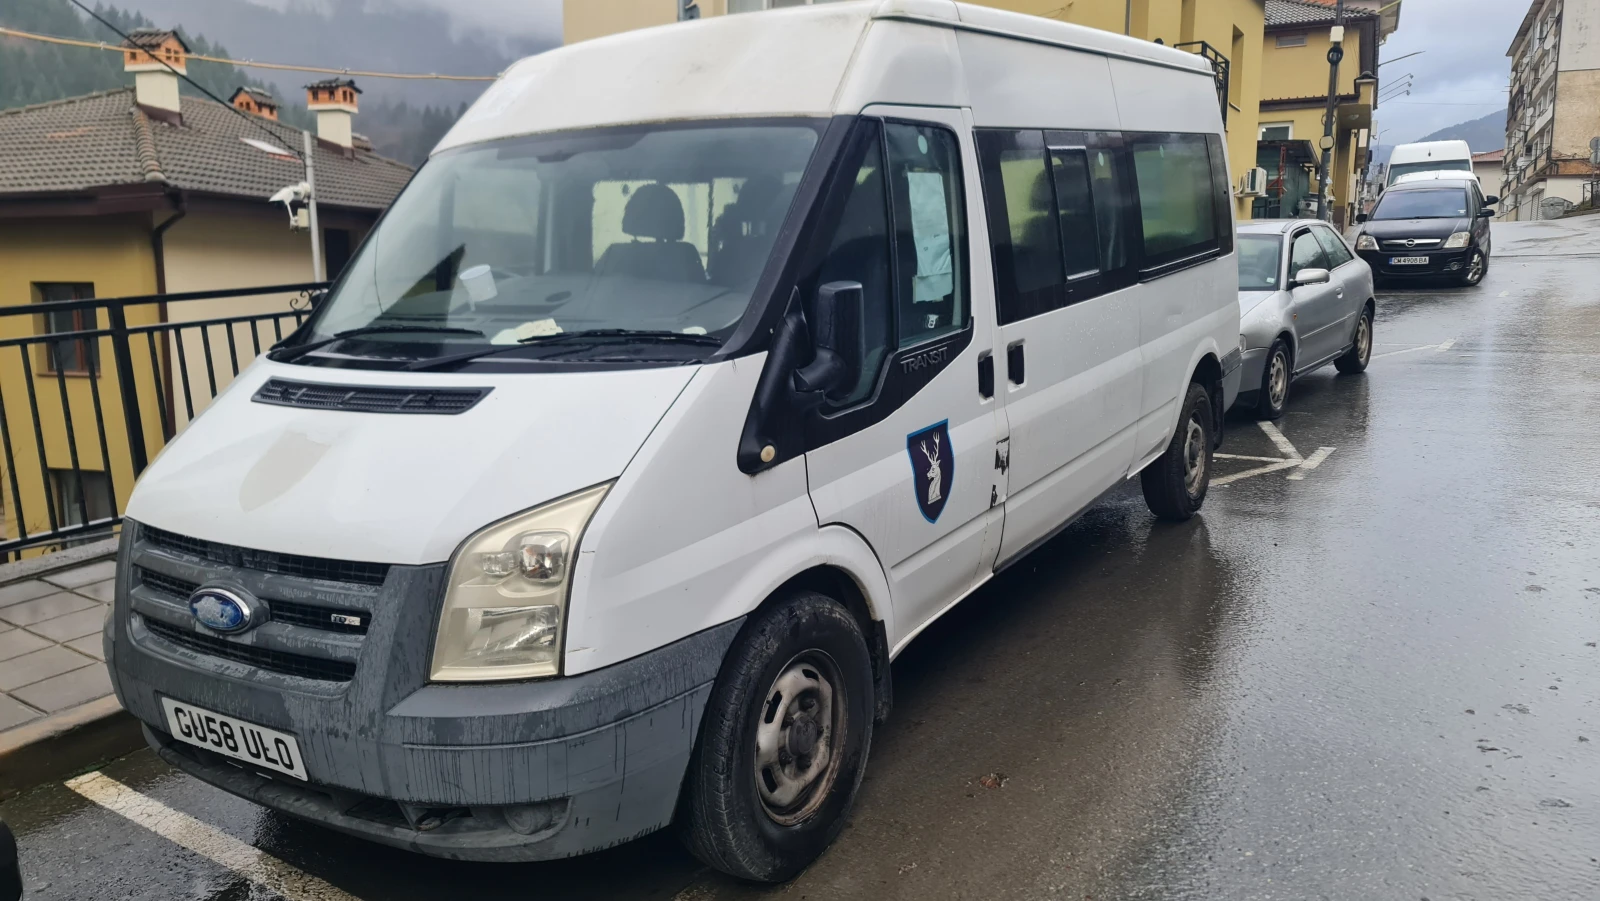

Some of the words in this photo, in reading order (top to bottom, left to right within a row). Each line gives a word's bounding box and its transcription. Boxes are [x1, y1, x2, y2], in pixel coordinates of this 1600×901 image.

[900, 346, 948, 374] TRANSIT
[173, 706, 239, 753] GU58
[239, 725, 295, 771] ULO
